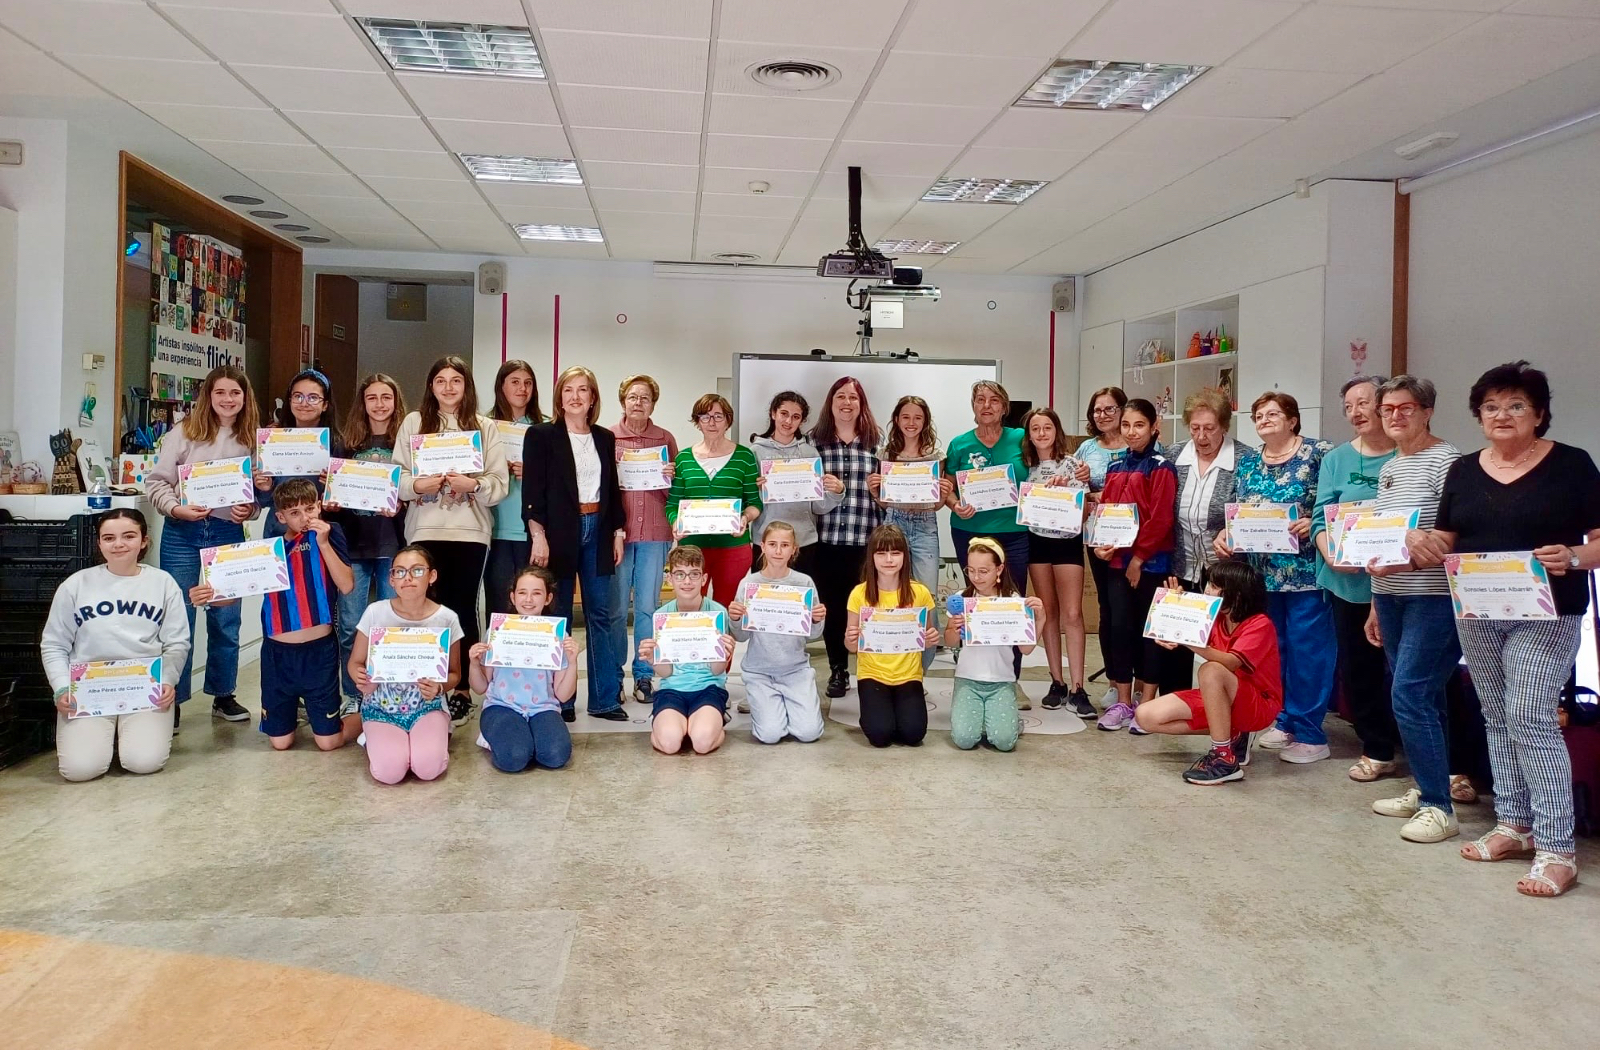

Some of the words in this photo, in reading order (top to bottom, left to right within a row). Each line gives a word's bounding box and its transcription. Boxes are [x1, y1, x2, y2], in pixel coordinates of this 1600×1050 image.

[158, 335, 181, 350] Artistas
[181, 340, 206, 356] insólitos,
[158, 351, 171, 362] una
[170, 353, 202, 368] experiencia
[73, 599, 164, 628] BROWNI
